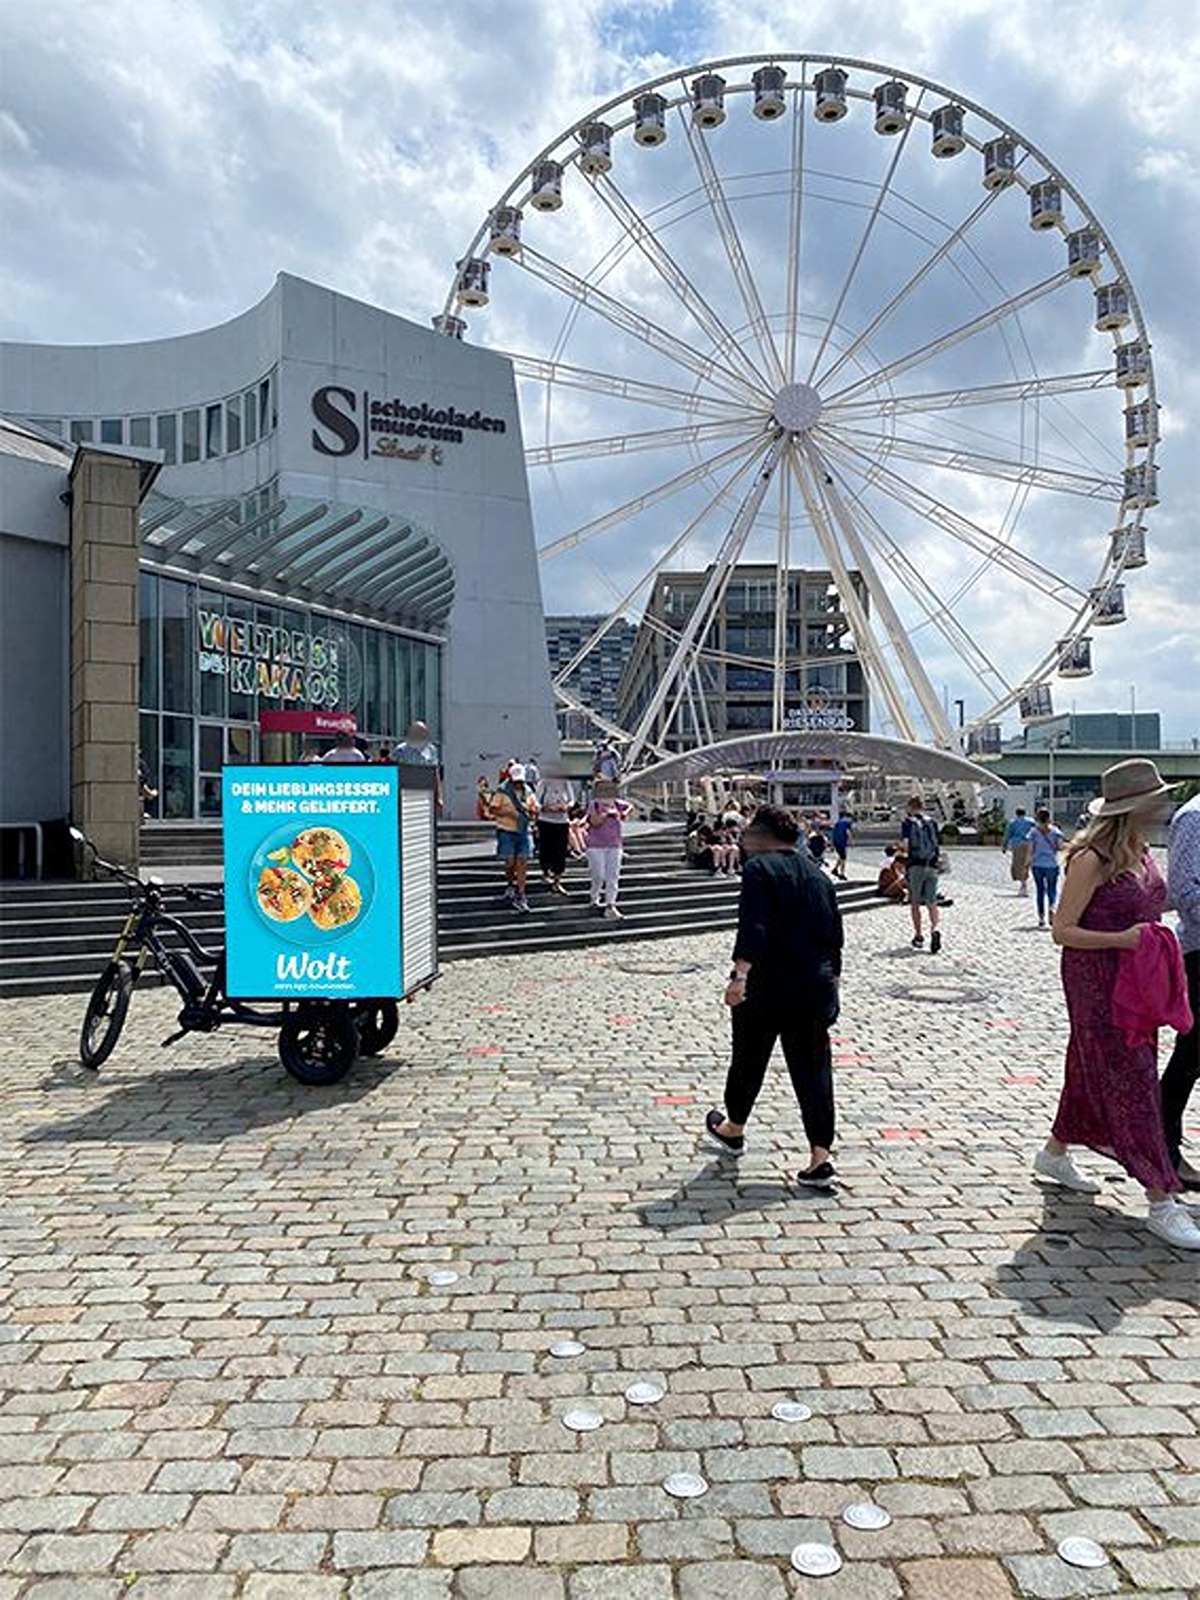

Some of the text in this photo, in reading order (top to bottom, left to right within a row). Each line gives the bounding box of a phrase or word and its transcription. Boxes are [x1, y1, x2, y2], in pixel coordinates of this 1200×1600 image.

[312, 385, 361, 457] S
[370, 398, 506, 434] schokoladen
[370, 416, 464, 444] museum
[230, 656, 340, 708] KAKAOS
[231, 782, 391, 796] DEIN LIEBLINGSESSEN
[240, 801, 381, 814] & MEHR GELIEFERT.
[276, 951, 352, 980] Wolt
